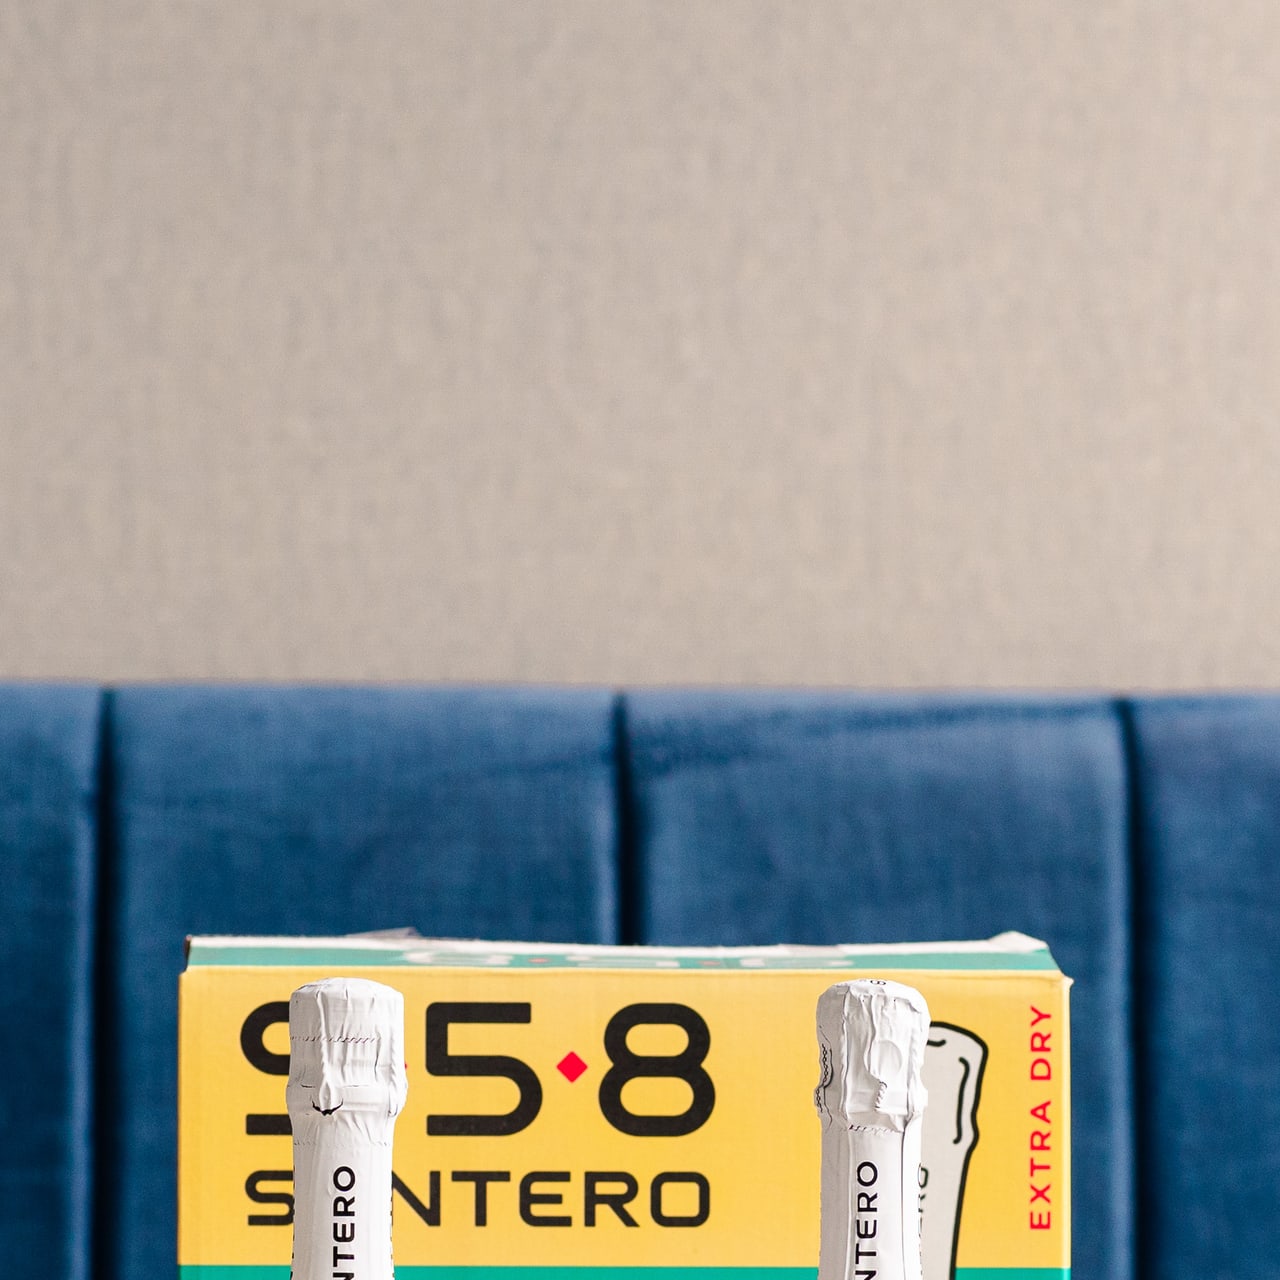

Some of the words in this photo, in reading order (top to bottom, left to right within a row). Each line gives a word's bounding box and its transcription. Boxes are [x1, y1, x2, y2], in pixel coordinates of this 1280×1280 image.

[1028, 1004, 1053, 1083] DRY
[245, 1171, 710, 1228] SNTERO
[1028, 1099, 1053, 1232] EXTRA
